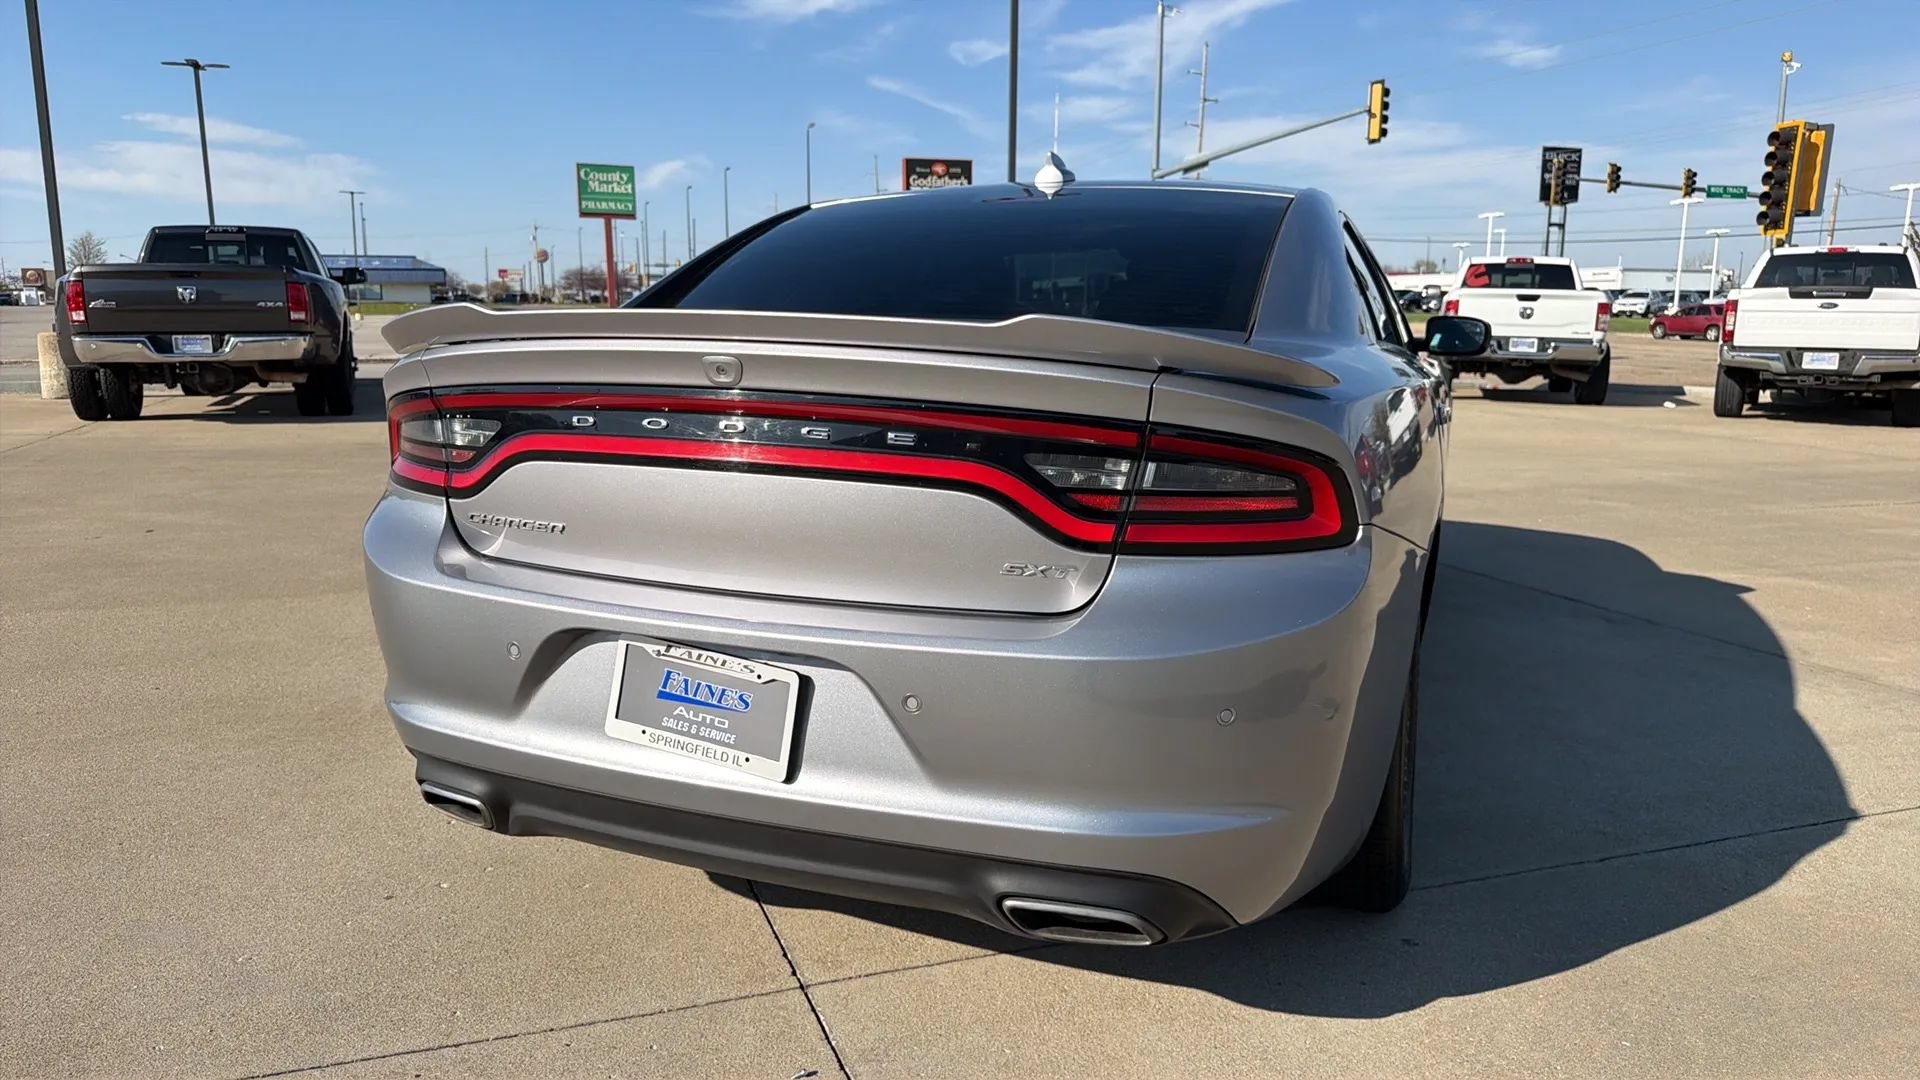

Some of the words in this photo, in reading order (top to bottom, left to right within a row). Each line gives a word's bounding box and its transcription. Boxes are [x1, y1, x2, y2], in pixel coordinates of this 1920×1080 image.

[1545, 151, 1580, 161] BUICK
[579, 167, 629, 184] County
[587, 180, 632, 194] Market
[909, 174, 969, 187] Godfather's
[581, 200, 633, 211] PHARMACY
[571, 415, 918, 446] DODGE
[469, 512, 566, 535] CHARGER
[1000, 562, 1078, 580] SXT
[663, 644, 757, 675] FAINE'S
[659, 667, 753, 713] FAINE'S
[672, 705, 730, 729] AUTO
[661, 716, 690, 733] SALES
[690, 723, 697, 734] &
[698, 726, 737, 745] SERVICE
[648, 732, 730, 762] SPRINGFIELD
[732, 755, 744, 767] IL
